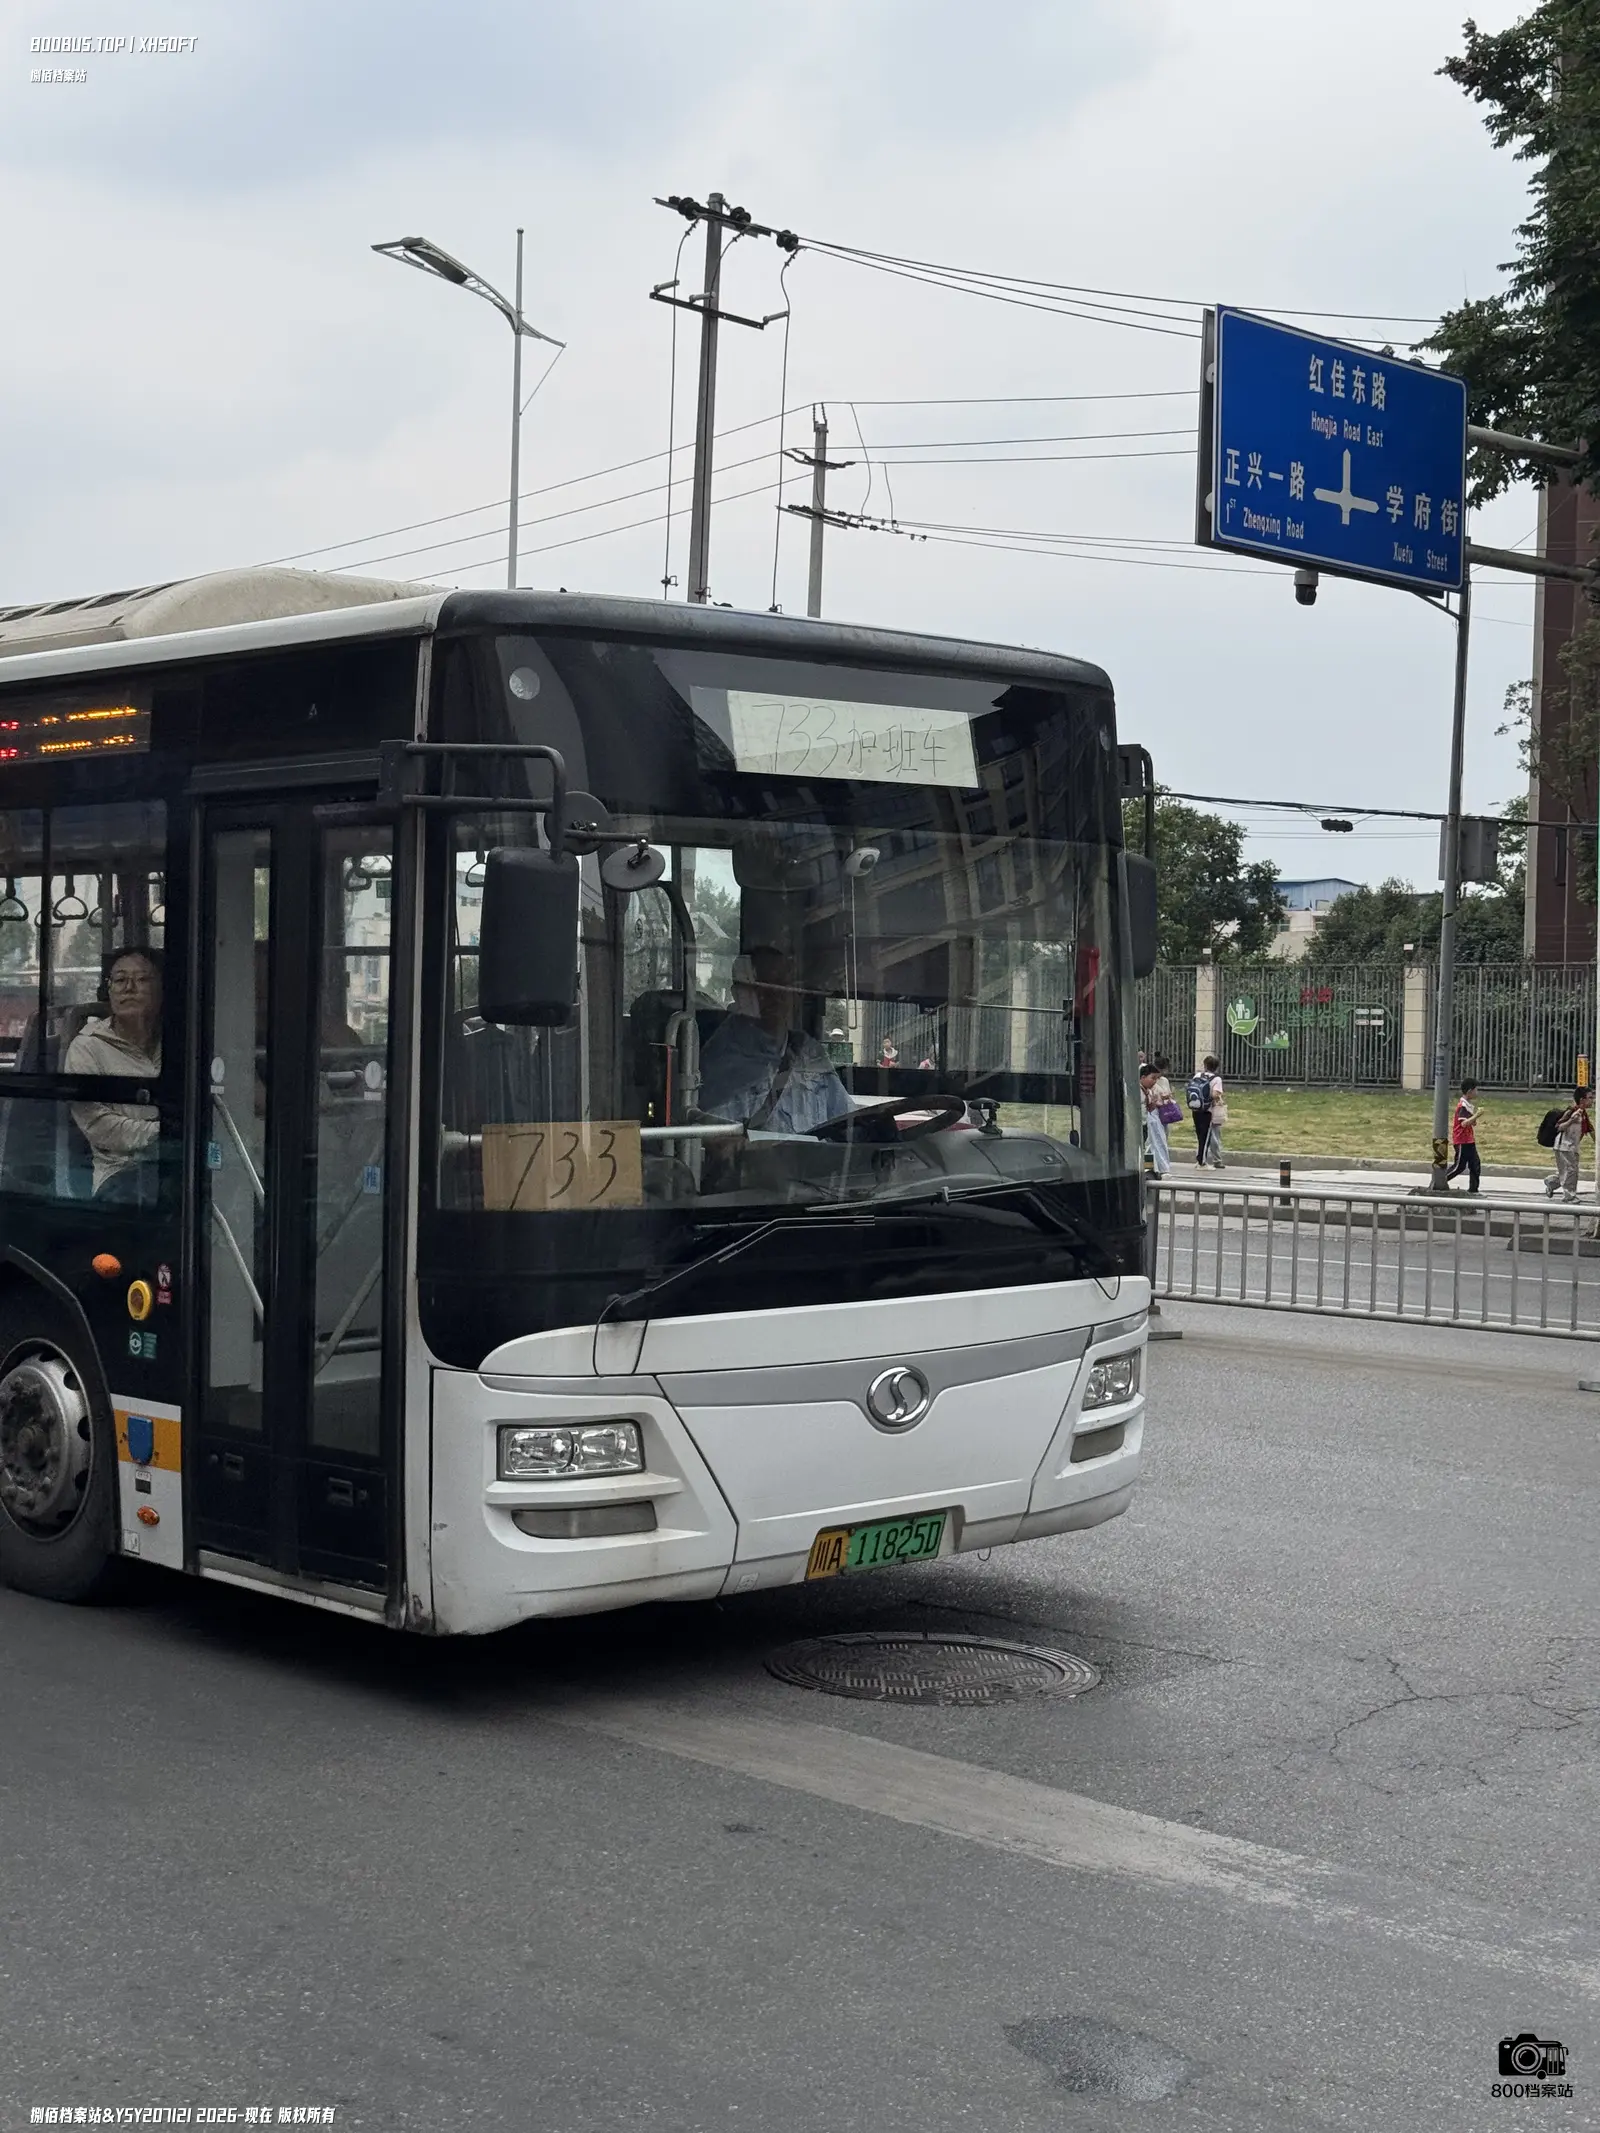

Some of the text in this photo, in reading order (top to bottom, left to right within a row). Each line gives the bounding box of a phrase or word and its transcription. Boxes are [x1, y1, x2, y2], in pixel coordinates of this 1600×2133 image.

[1309, 354, 1386, 411] 红佳东路
[1311, 411, 1384, 447] Hongjia Road East
[1224, 448, 1305, 501] 正兴一路
[1243, 507, 1281, 540] Zhengxing
[1286, 517, 1304, 540] Road
[1386, 485, 1458, 537] 学府街
[1393, 542, 1448, 572] Xuefu Street
[508, 1130, 617, 1209] 733
[855, 1521, 941, 1565] 11825D
